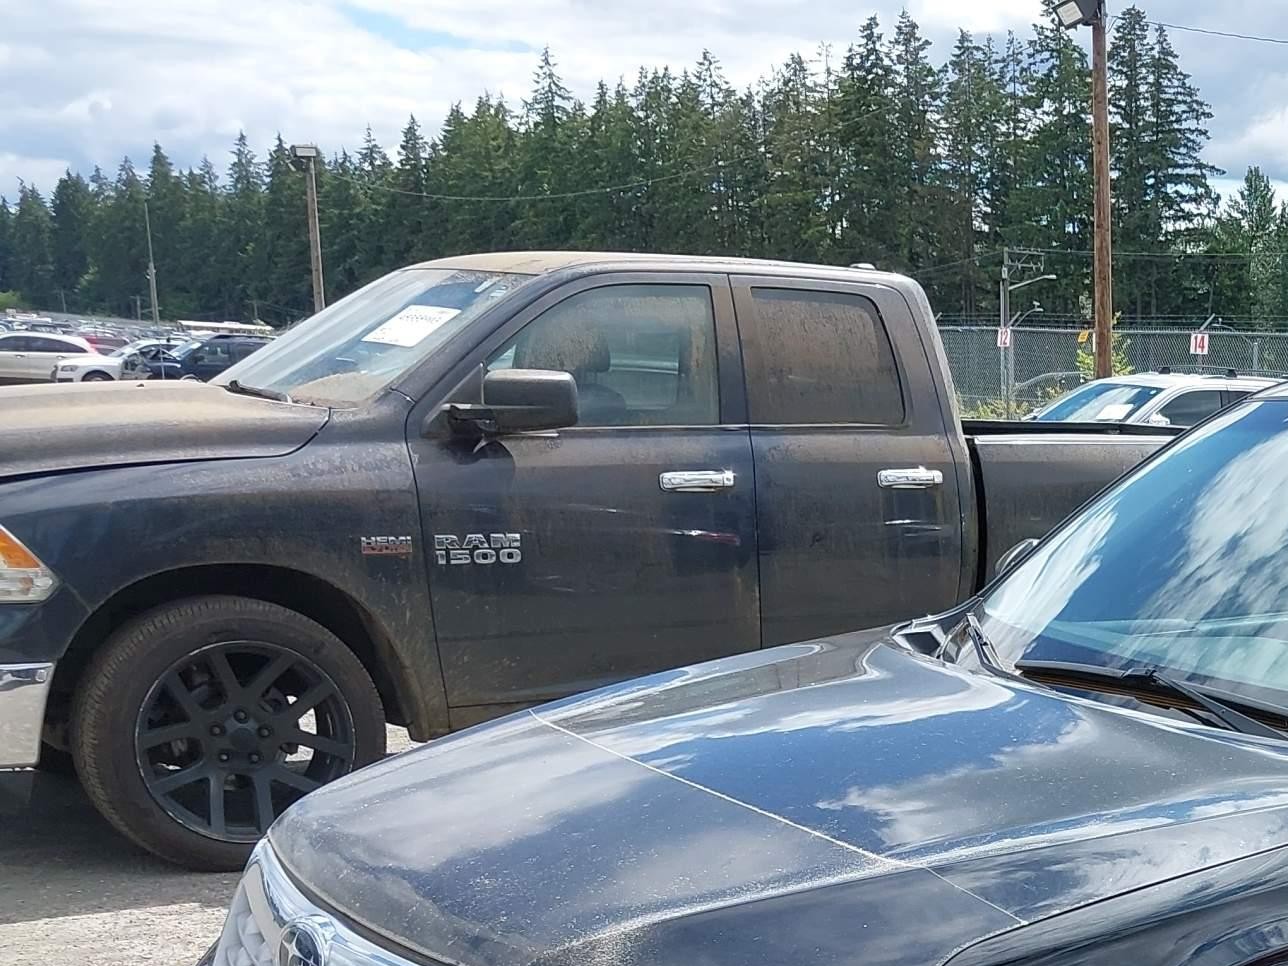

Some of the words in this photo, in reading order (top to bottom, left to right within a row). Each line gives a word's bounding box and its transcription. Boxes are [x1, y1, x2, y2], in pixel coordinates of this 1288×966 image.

[1194, 335, 1205, 353] 14
[361, 536, 411, 544] HEMI
[434, 533, 520, 549] RAM
[435, 549, 521, 564] 1500
